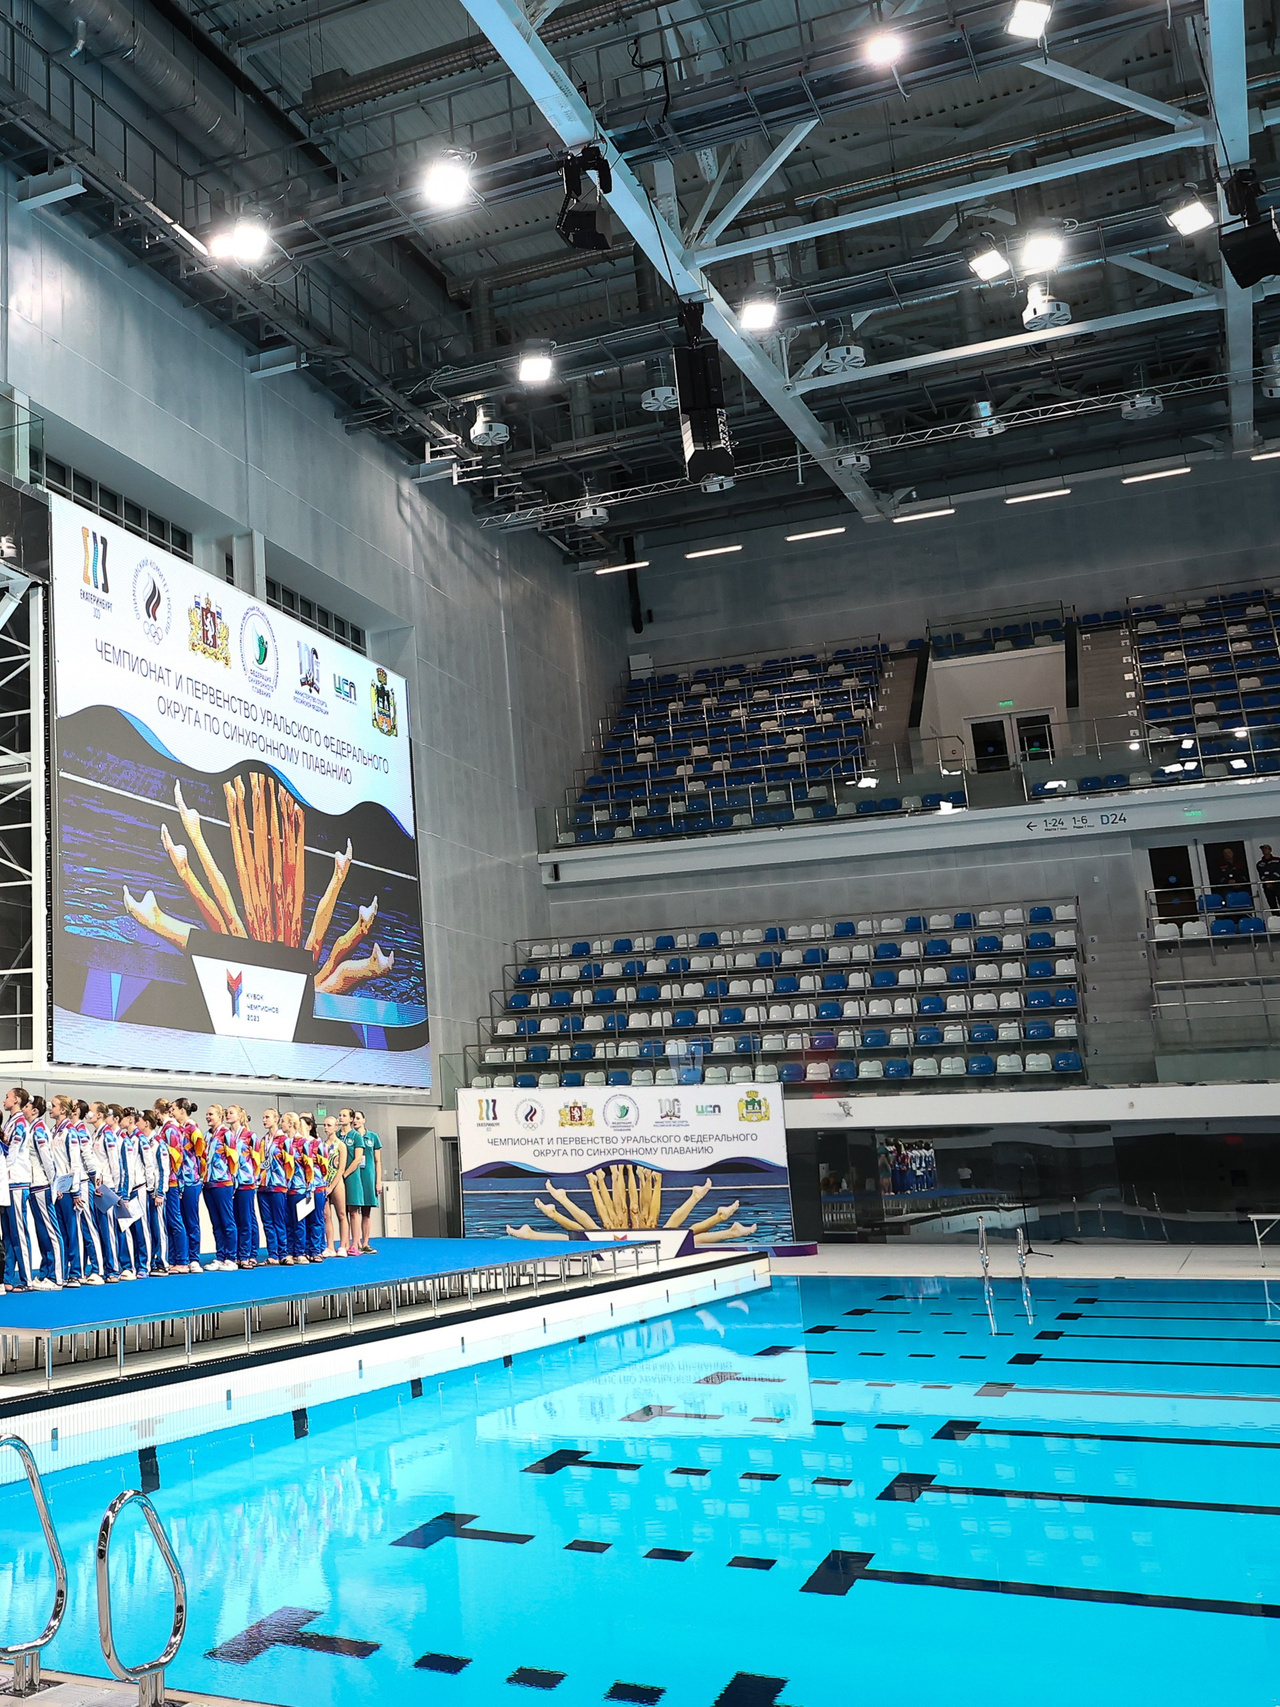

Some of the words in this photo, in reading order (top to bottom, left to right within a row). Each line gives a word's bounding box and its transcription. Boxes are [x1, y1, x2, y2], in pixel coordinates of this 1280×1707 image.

[95, 638, 171, 687] ЧЕМПИОНАТ
[175, 672, 183, 692] И
[186, 677, 258, 721] ПЕРВЕНСТВО
[260, 706, 321, 747] УРАЛЬСКОГО
[323, 734, 389, 774] ФЕДЕРАЛЬНОГО
[157, 695, 202, 729] ОКРУГА
[204, 713, 220, 735] ПО
[223, 721, 300, 765] СИНХРОННОМУ
[302, 751, 352, 785] ПЛАВАНИЮ
[1043, 818, 1064, 827] 1-24
[1072, 816, 1087, 824] 1-6
[1100, 813, 1127, 825] D24
[487, 1137, 544, 1146] ЧЕМПИОНАТ
[547, 1137, 554, 1145] И
[557, 1136, 618, 1145] ПЕРВЕНСТВО
[621, 1135, 681, 1144] УРАЛЬСКОГО
[683, 1133, 758, 1143] ФЕДЕРАЛЬНОГО
[533, 1149, 568, 1157] ОКРУГА
[571, 1148, 584, 1156] ПО
[587, 1147, 658, 1157] СИНХРОННОМУ
[661, 1145, 713, 1154] ПЛАВАНИЮ
